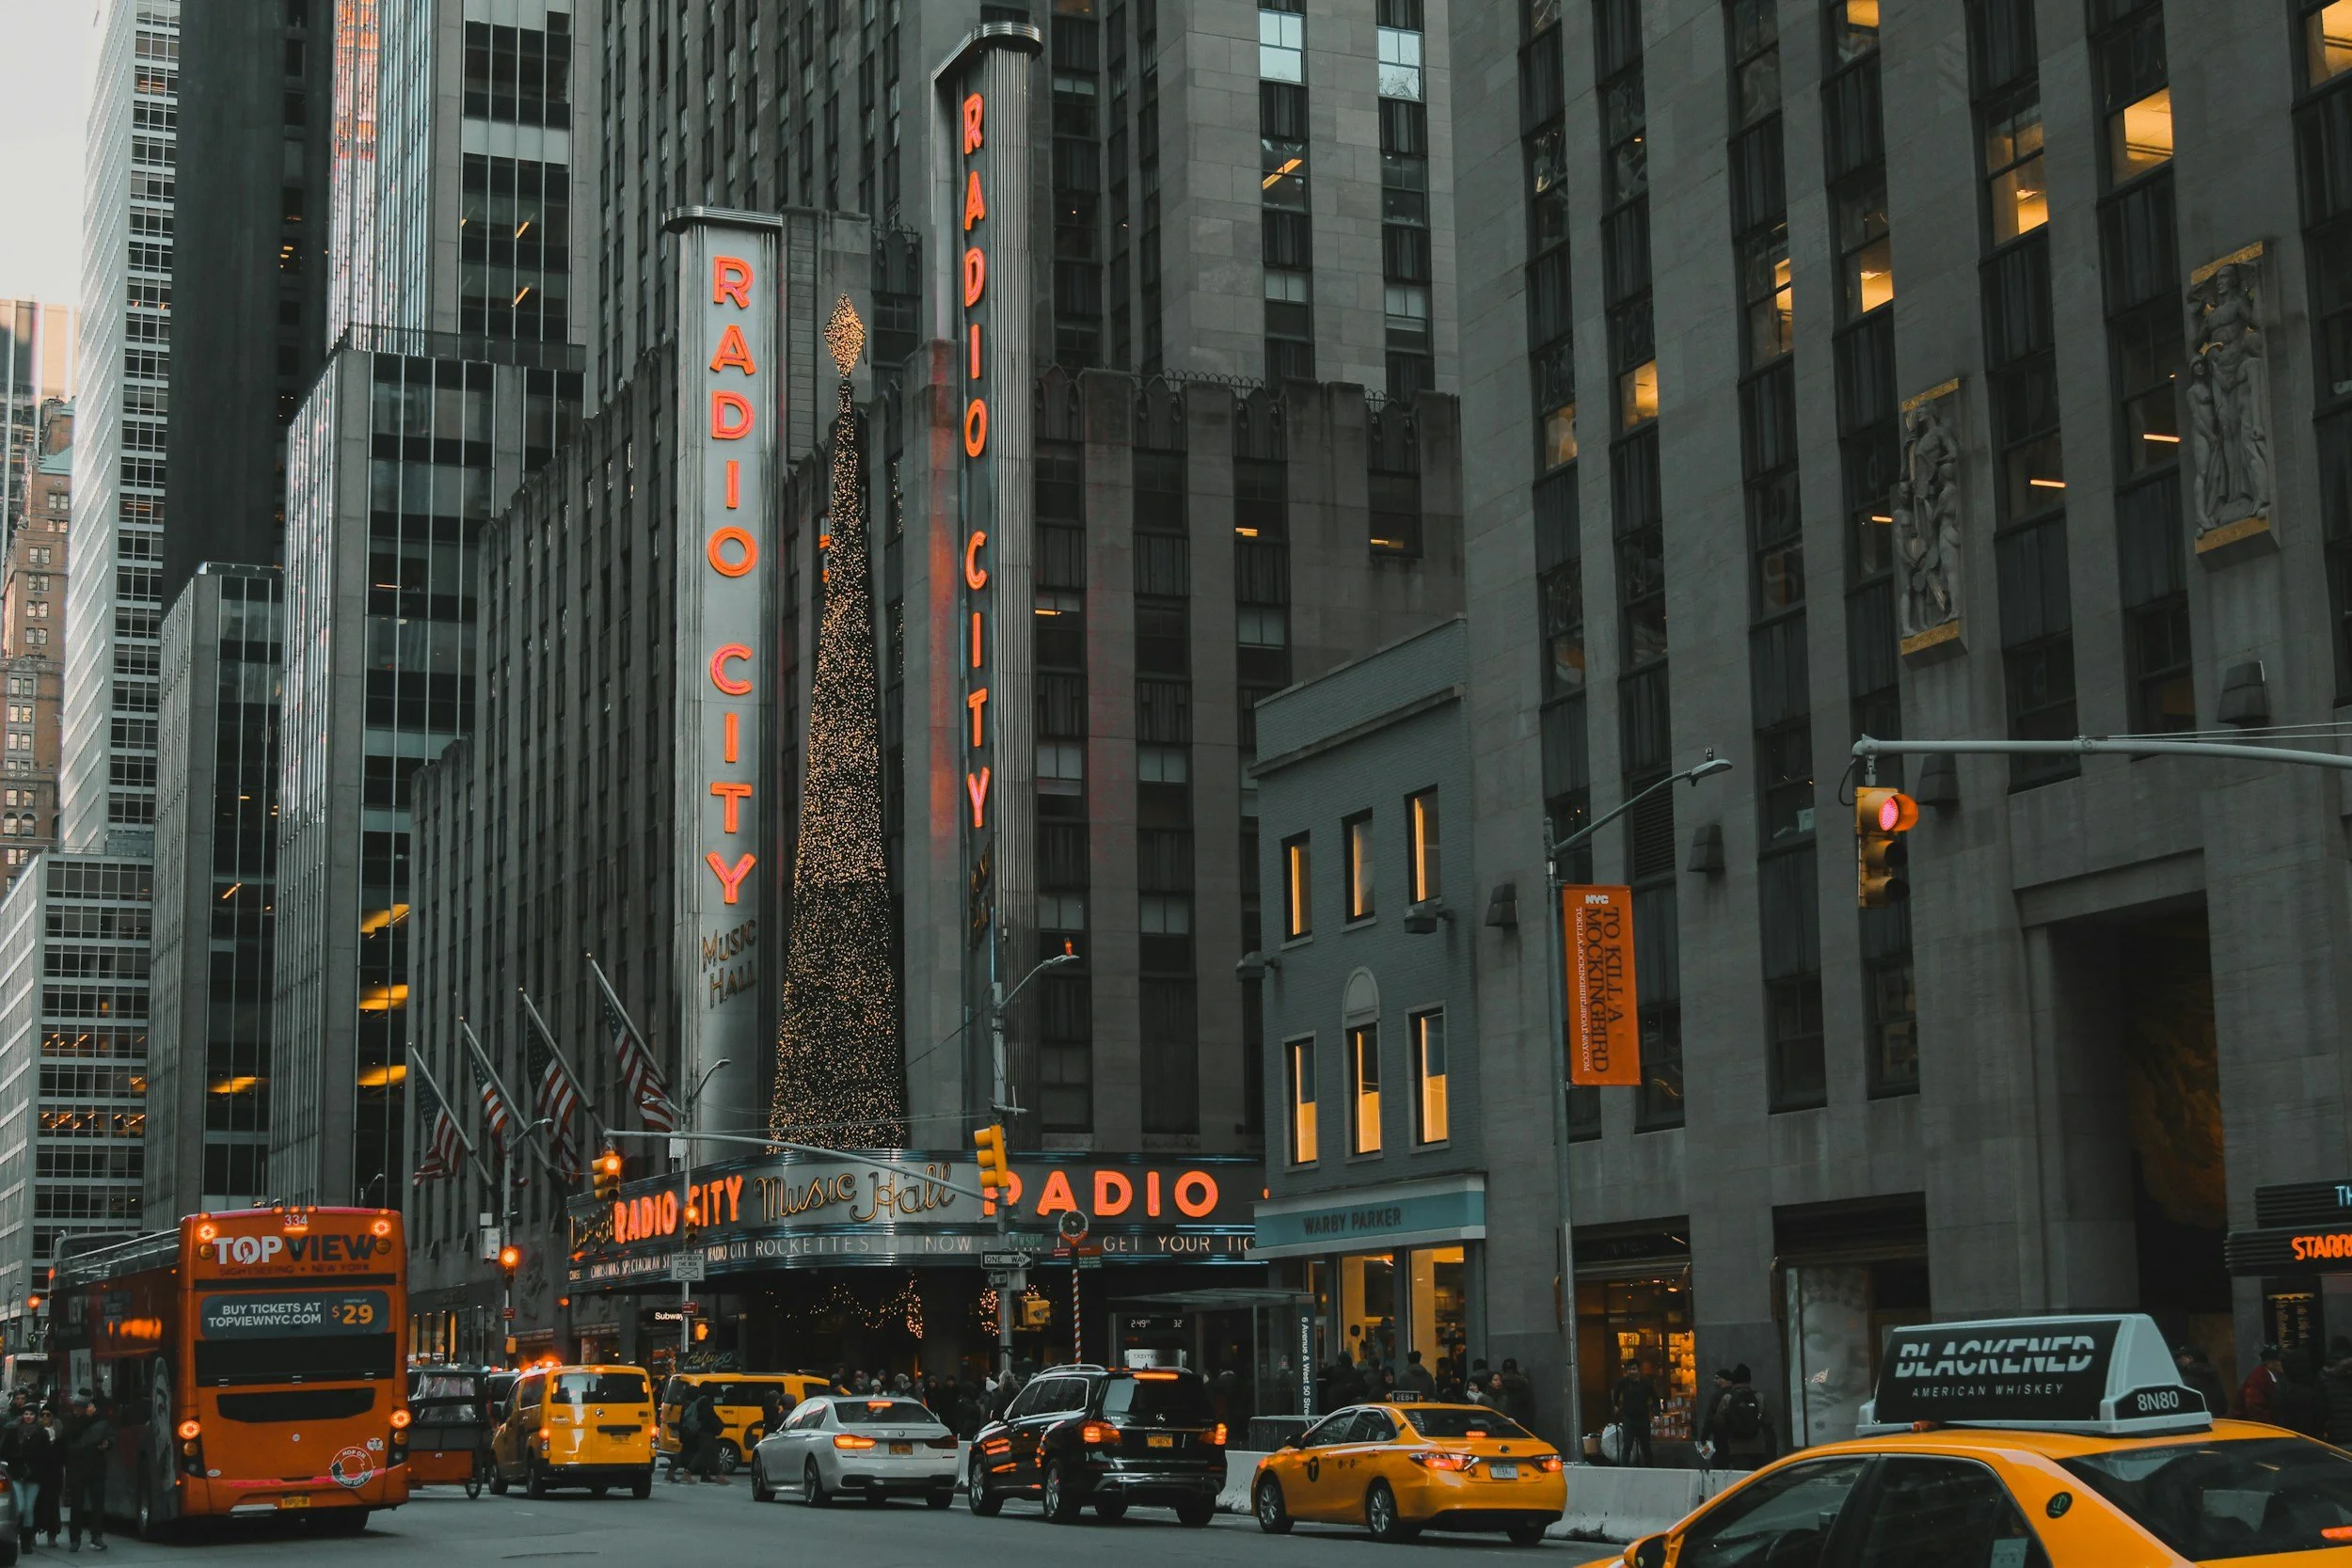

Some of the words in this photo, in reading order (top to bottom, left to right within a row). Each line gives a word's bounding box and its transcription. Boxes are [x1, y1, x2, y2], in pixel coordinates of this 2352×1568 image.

[963, 92, 989, 457] RADIO
[707, 255, 758, 578] RADIO
[965, 530, 991, 828] CITY
[706, 642, 757, 904] CITY
[1585, 895, 1609, 904] NYC
[1604, 907, 1621, 940] TO
[702, 919, 756, 974] MUSIC
[709, 960, 756, 1009] HALL
[1605, 946, 1623, 1001] KILL
[1585, 908, 1609, 1073] MOCKINGBIRD
[1608, 1008, 1625, 1022] A
[754, 1173, 857, 1222] Music
[850, 1163, 957, 1222] Hall
[284, 1213, 309, 1227] 334
[613, 1190, 678, 1244] RADIO
[689, 1175, 744, 1227] CITY
[1303, 1212, 1346, 1235] WARBY
[1351, 1207, 1402, 1230] PARKER
[707, 1244, 727, 1262] RADIO
[730, 1241, 748, 1259] CITY
[755, 1235, 869, 1258] ROCKETTES
[925, 1235, 972, 1253] NOW
[1103, 1235, 1138, 1253] GET
[1157, 1235, 1210, 1253] YOUR
[2291, 1233, 2352, 1261] STARR
[218, 1265, 294, 1276] SIGHTSEEING
[208, 1314, 322, 1327] TOPVIEWNYC.COM
[222, 1304, 246, 1315] BUY
[250, 1303, 301, 1314] TICKETS
[304, 1302, 321, 1312] AT
[655, 1312, 684, 1322] Subway
[1895, 1336, 2095, 1378] BLACKENED
[1303, 1386, 1311, 1396] 50
[1912, 1384, 1987, 1398] AMERICAN
[1995, 1383, 2064, 1396] WHISKEY
[2137, 1390, 2179, 1412] 8N80
[358, 1450, 367, 1459] ON
[339, 1477, 353, 1485] HOP
[354, 1477, 365, 1486] OFF
